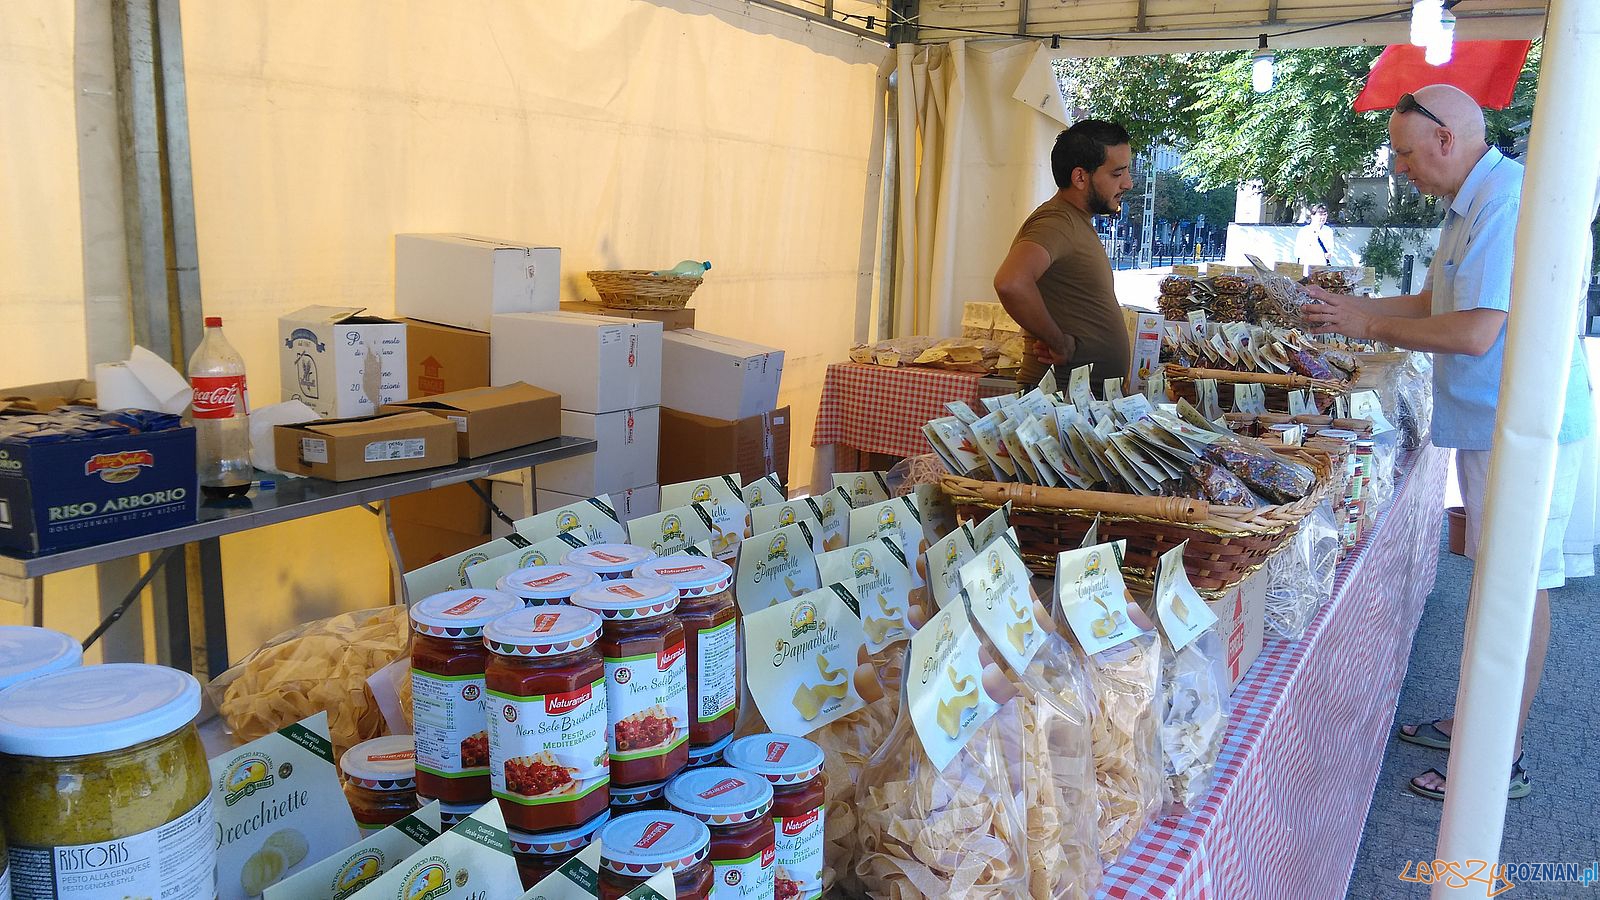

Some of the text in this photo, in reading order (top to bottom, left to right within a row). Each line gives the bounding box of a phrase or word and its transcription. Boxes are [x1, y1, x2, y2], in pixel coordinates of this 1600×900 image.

[350, 383, 360, 391] 20
[48, 487, 186, 521] RISO ARBORIO
[773, 626, 838, 667] Pappardelle
[629, 682, 647, 696] Non
[549, 692, 591, 711] Naturamica
[515, 724, 535, 737] Non
[538, 719, 561, 735] Solo
[785, 815, 817, 832] Naturamica
[775, 840, 793, 851] Solo
[59, 841, 129, 871] RISTORIS
[61, 861, 152, 884] PESTO ALLA GENOVESE
[116, 875, 136, 886] STYLE
